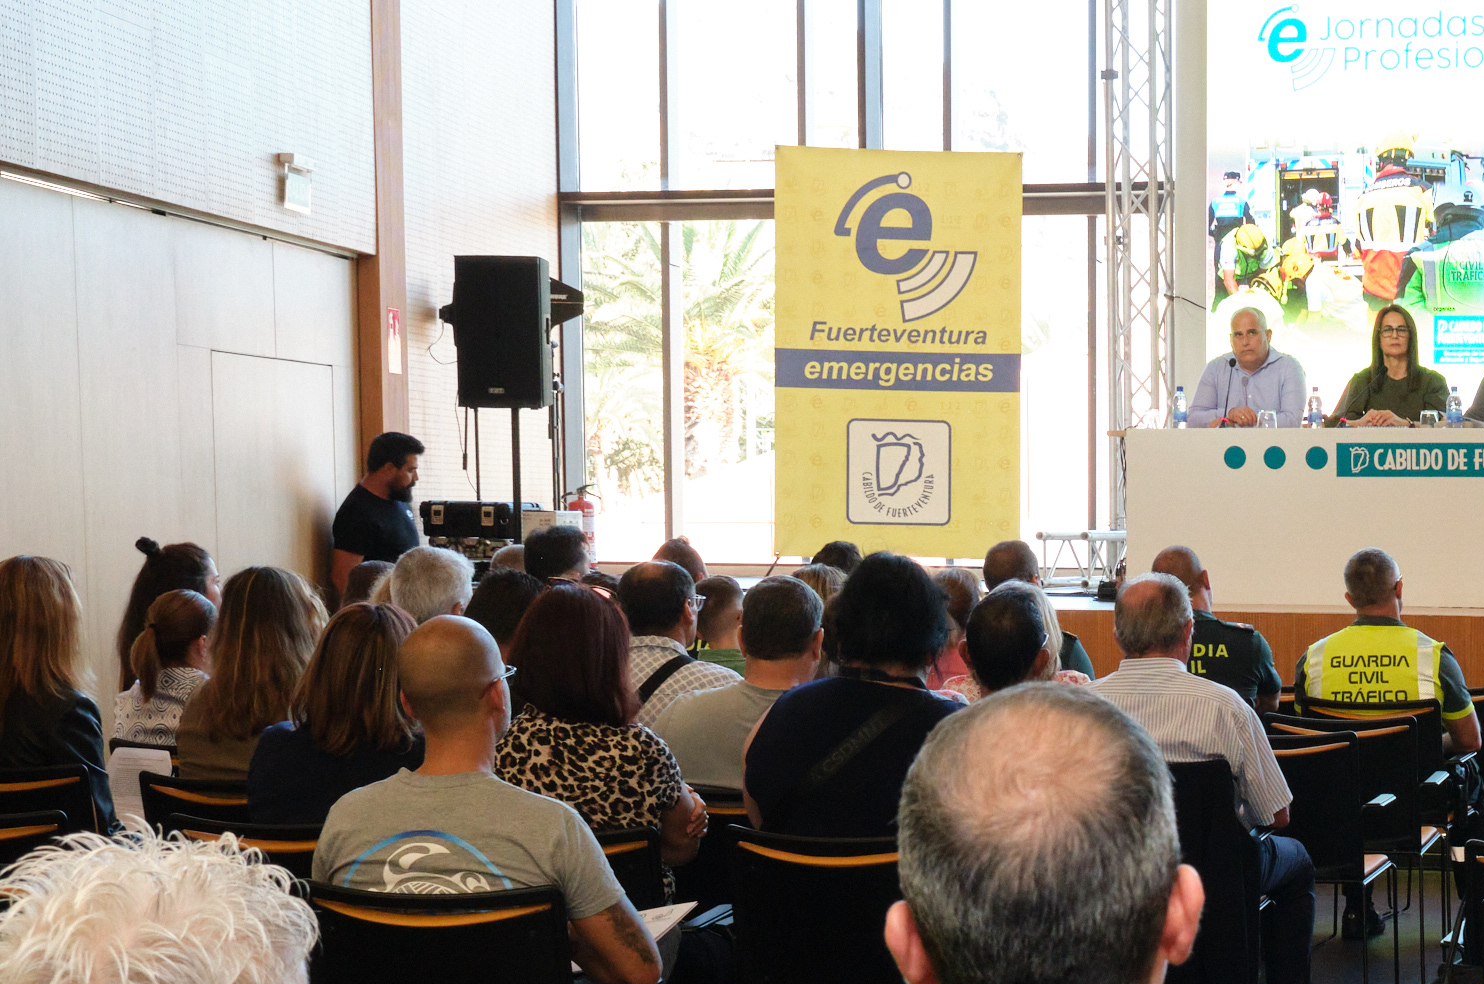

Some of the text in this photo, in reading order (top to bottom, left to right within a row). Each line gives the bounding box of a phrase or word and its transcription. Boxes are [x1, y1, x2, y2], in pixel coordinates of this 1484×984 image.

[1319, 10, 1484, 41] Jornadas
[809, 320, 988, 346] Fuerteventura
[804, 356, 995, 388] emergencias
[1373, 448, 1443, 471] CABILDO
[1447, 448, 1468, 470] DE
[862, 471, 934, 518] CABILDO DE FUERTEVENTURA
[1193, 643, 1229, 658] DIA
[1330, 654, 1410, 668] GUARDIA
[1348, 670, 1389, 685] CIVIL
[1330, 687, 1408, 703] TRÁFICO
